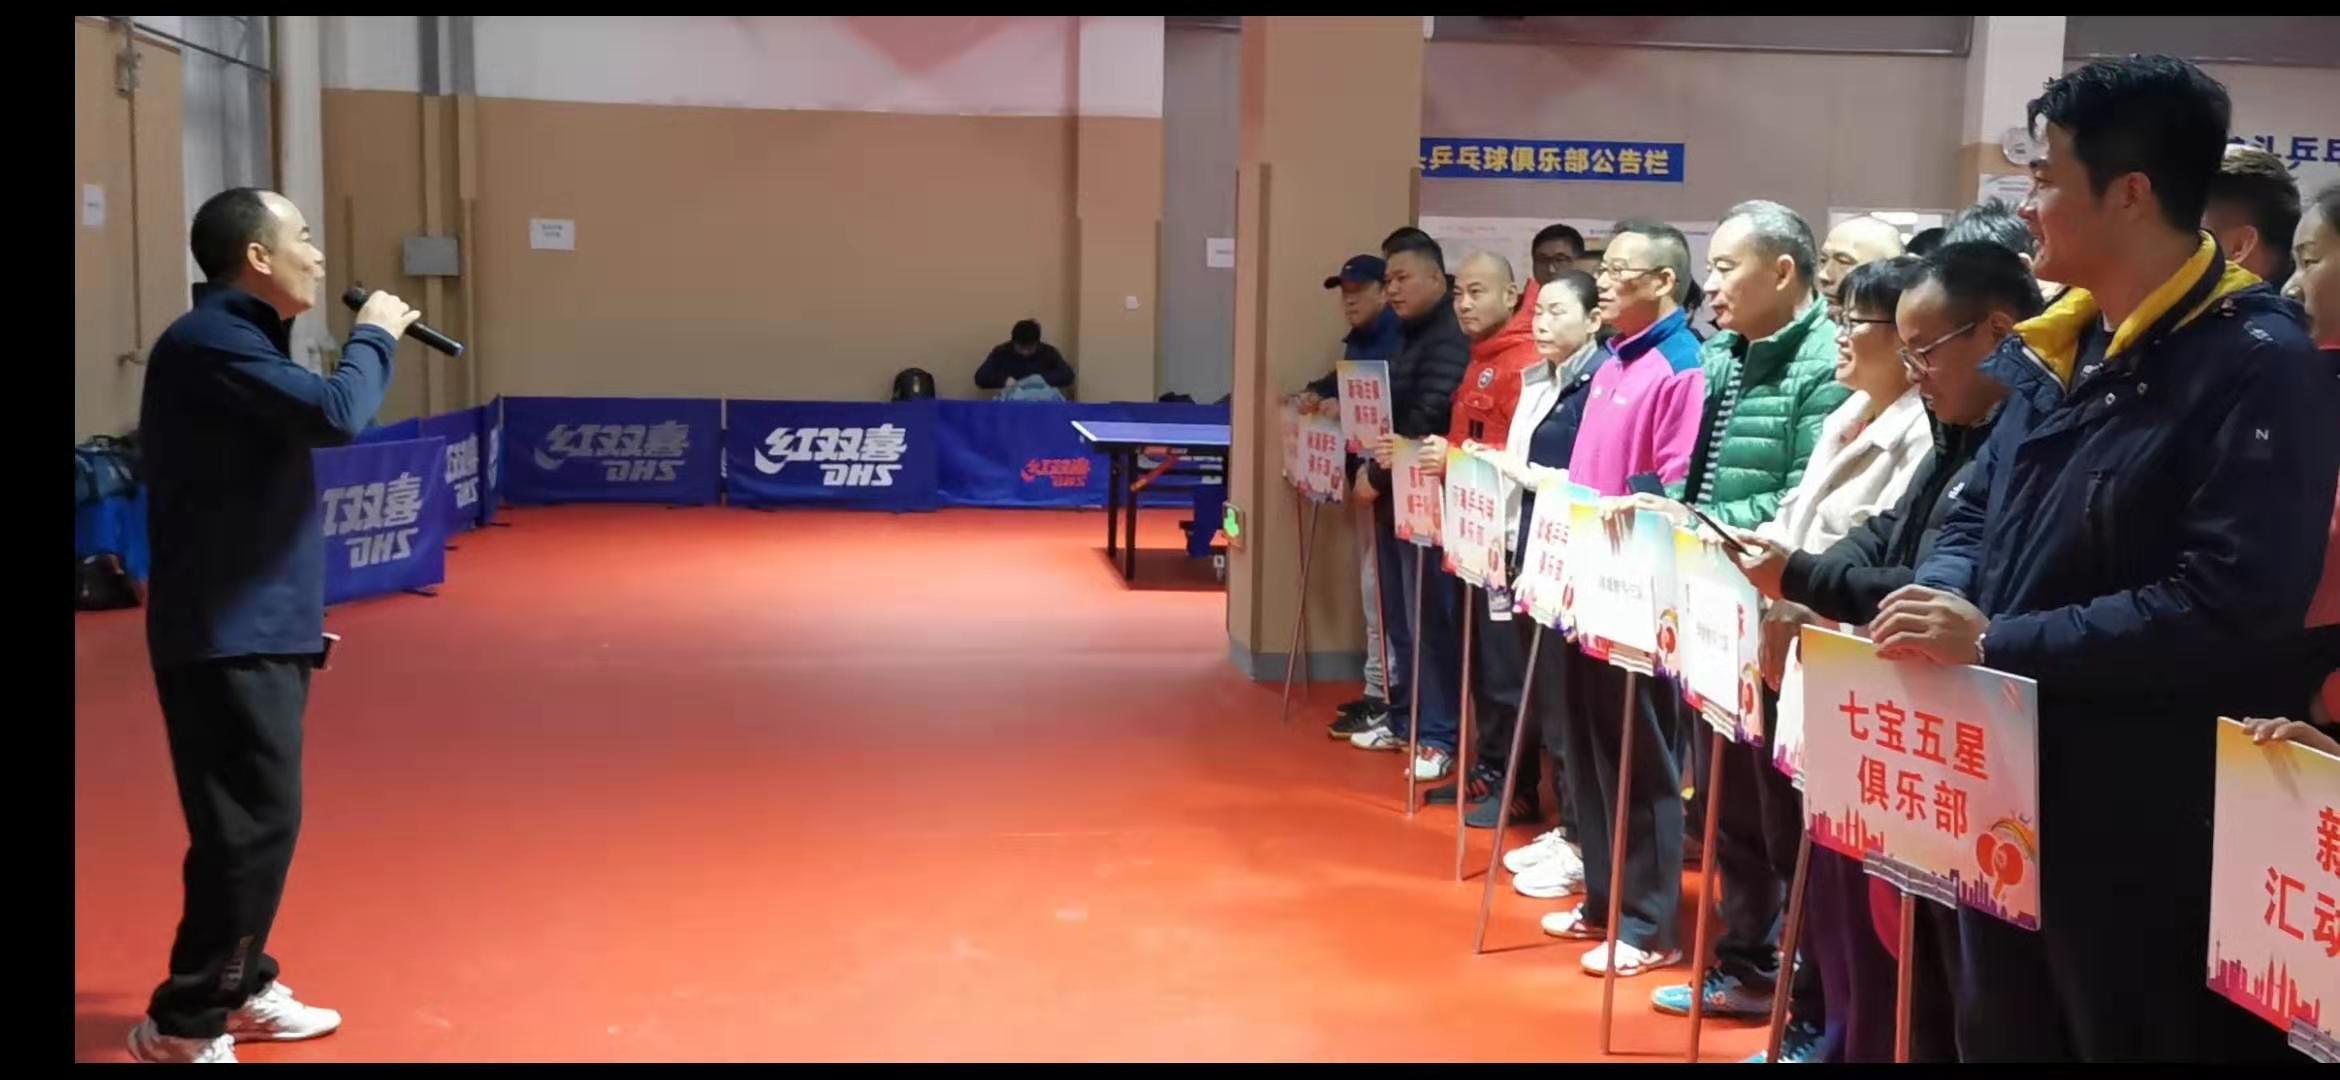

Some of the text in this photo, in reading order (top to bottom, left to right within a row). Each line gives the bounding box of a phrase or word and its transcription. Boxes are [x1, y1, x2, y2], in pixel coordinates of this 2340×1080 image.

[1420, 144, 1670, 176] 乒乓球俱乐部公告栏
[534, 420, 690, 470] 红双喜
[754, 422, 907, 475] 红双喜
[2255, 428, 2269, 440] N
[598, 459, 686, 481] DHS
[818, 463, 904, 486] DHS
[344, 527, 420, 569] DHS
[1839, 690, 1989, 781] 七宝五星
[1857, 755, 1969, 840] 俱乐部
